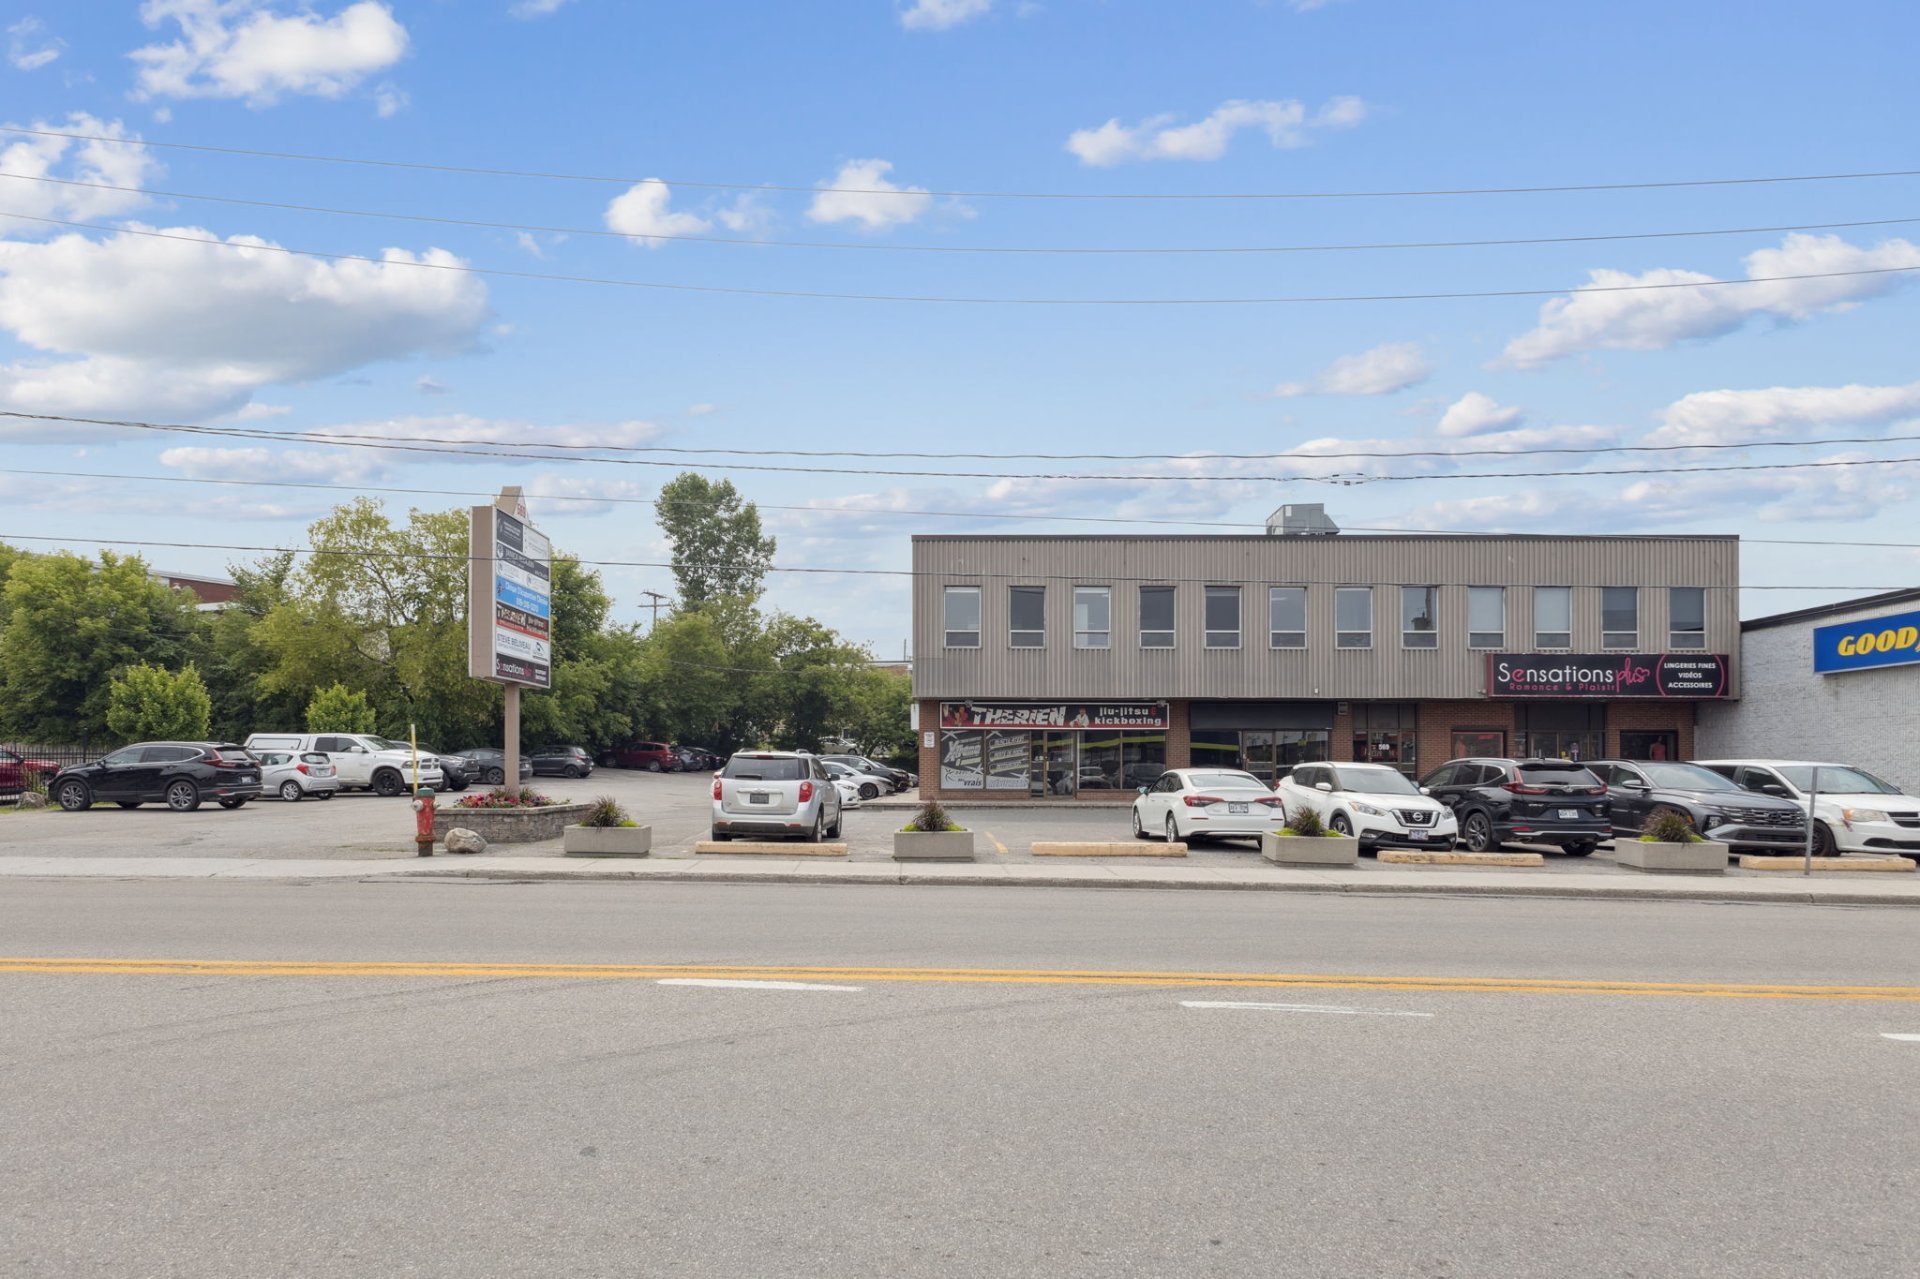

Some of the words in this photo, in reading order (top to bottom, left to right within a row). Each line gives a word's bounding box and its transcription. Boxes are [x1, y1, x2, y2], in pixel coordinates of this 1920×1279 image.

[1837, 626, 1919, 656] GOOD
[1497, 663, 1614, 683] Sensations
[1615, 657, 1649, 692] plus
[1509, 682, 1559, 691] Romance
[1578, 682, 1615, 691] Plaisir
[971, 705, 1067, 726] THERIEN
[1099, 707, 1149, 717] jiu-jitsu
[1094, 716, 1162, 727] kickboxing
